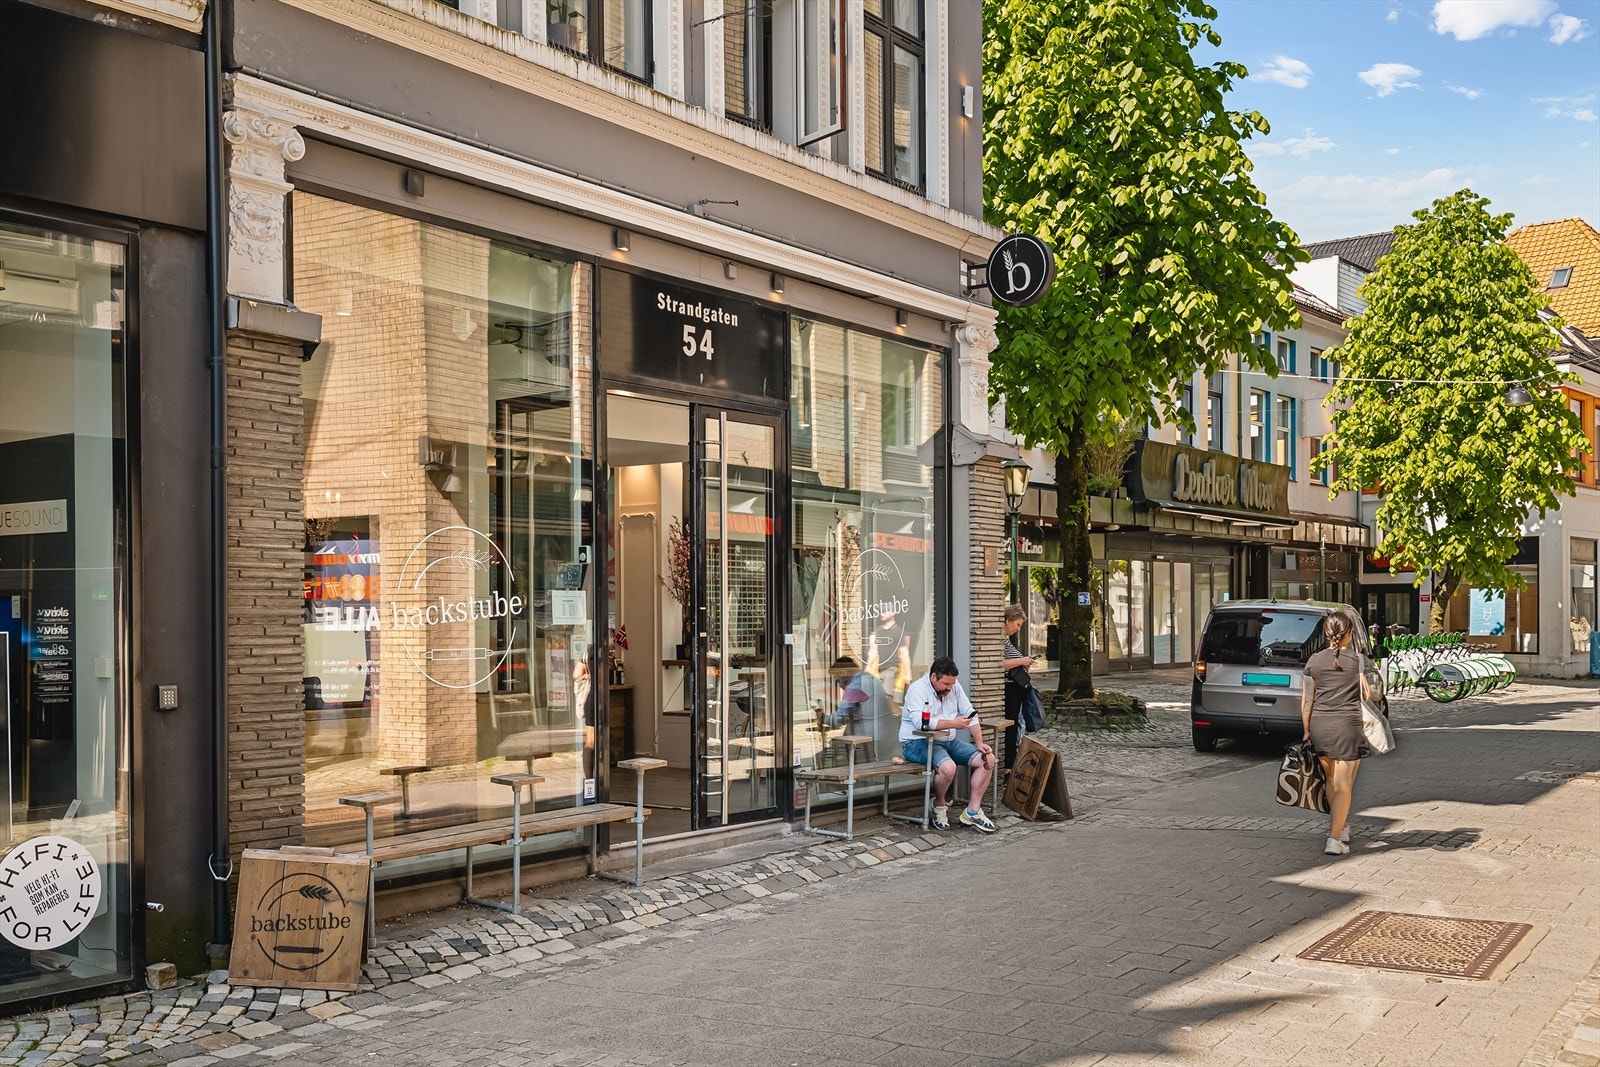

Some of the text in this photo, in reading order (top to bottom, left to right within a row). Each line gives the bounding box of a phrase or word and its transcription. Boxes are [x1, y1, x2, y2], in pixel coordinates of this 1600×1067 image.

[657, 292, 738, 327] Strandgaten
[682, 324, 714, 360] 54
[1173, 452, 1236, 505] Leather
[391, 591, 523, 630] backstube
[839, 595, 909, 624] backstube
[0, 843, 67, 888] HIFI
[24, 868, 60, 895] VELG HI-FI
[0, 861, 94, 942] FOR LIFE
[29, 883, 59, 906] SOM KAN
[34, 889, 70, 916] REPARERES
[250, 912, 351, 932] backstube
